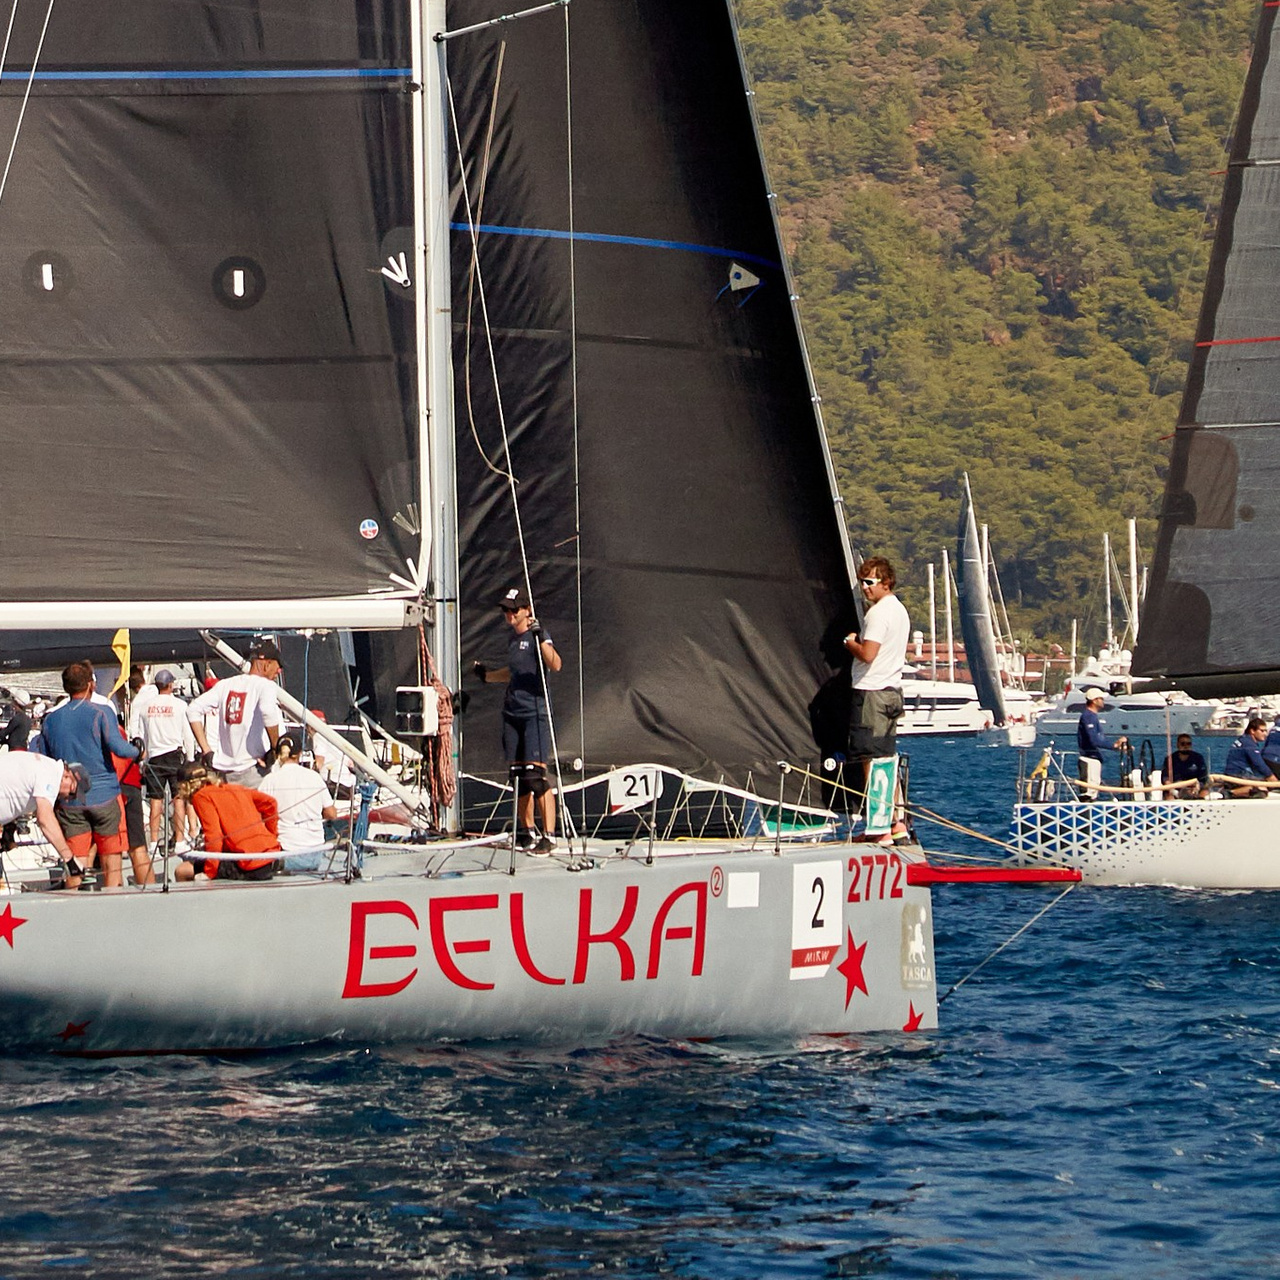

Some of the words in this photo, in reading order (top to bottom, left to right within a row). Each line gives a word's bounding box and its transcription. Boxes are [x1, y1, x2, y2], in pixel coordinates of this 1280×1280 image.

[623, 774, 650, 797] 21
[873, 769, 888, 828] 2
[811, 877, 825, 929] 2
[847, 853, 903, 903] 2772
[341, 881, 708, 999] BELKA
